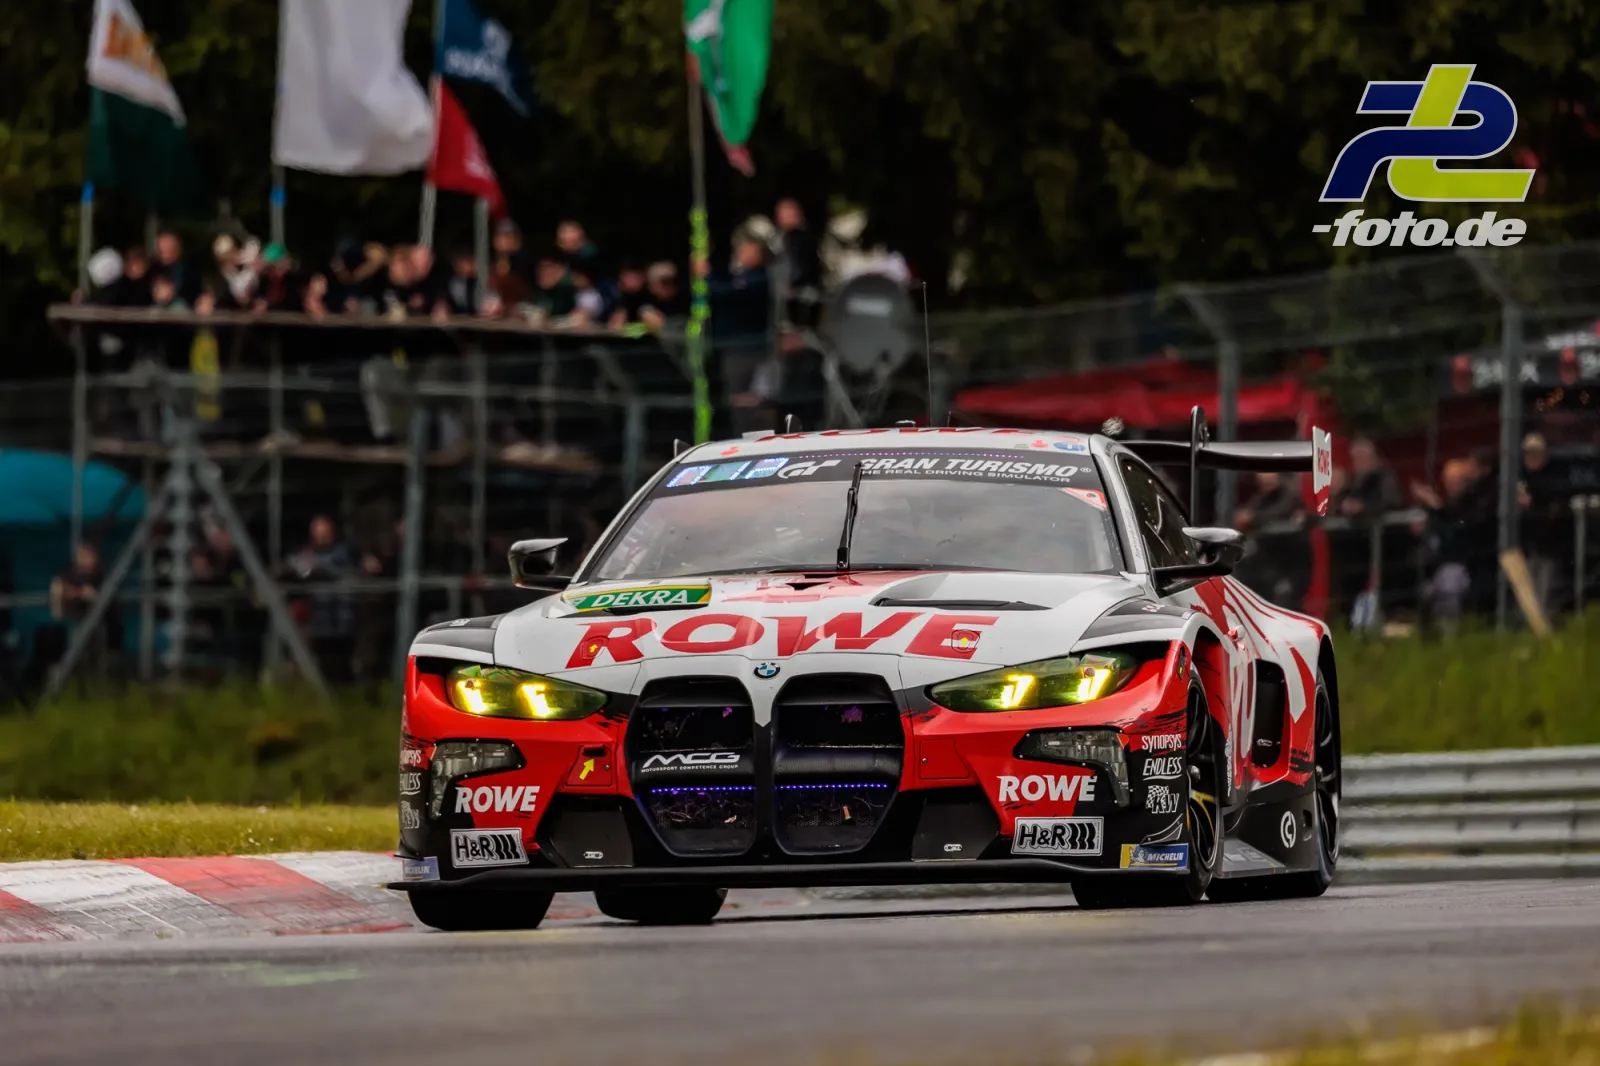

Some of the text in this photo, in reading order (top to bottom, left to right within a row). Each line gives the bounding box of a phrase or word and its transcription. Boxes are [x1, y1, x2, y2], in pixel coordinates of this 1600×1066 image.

[860, 458, 938, 470] GRAN
[987, 472, 1071, 482] SIMULATOR
[591, 589, 688, 607] DEKRA
[565, 612, 999, 669] ROWE
[1141, 734, 1182, 752] SYNOPSYS
[642, 752, 741, 769] MCG
[1142, 756, 1182, 776] ENDLESS
[996, 775, 1098, 802] ROWE
[455, 786, 540, 813] ROWE
[1017, 823, 1070, 850] H&R
[454, 833, 500, 862] H&R
[1147, 852, 1184, 862] MICHELIN
